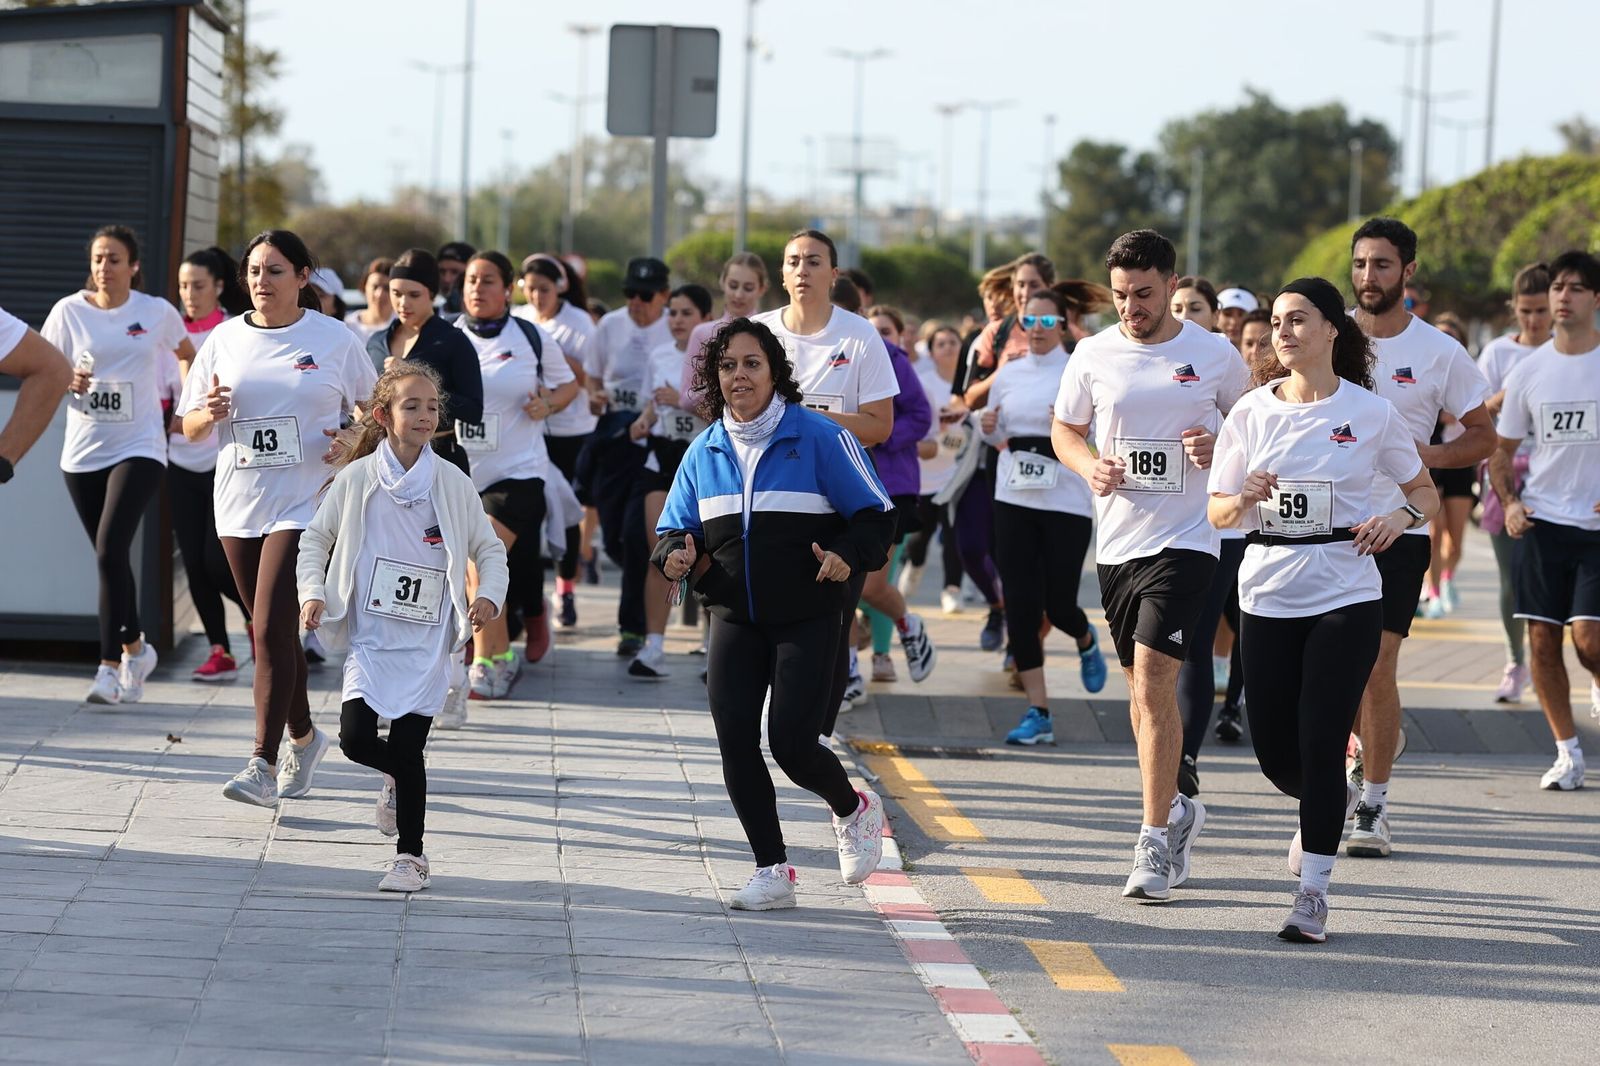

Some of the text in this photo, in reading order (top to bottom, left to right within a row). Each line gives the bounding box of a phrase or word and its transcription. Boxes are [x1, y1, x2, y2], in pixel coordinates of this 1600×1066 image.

[90, 391, 121, 410] 348
[675, 416, 693, 432] 55
[1553, 411, 1585, 430] 277
[252, 428, 278, 452] 43
[459, 422, 486, 439] 164
[1019, 461, 1045, 476] 183
[1129, 451, 1168, 476] 189
[1279, 493, 1308, 519] 59
[395, 575, 422, 603] 31
[1168, 635, 1183, 645] adidas
